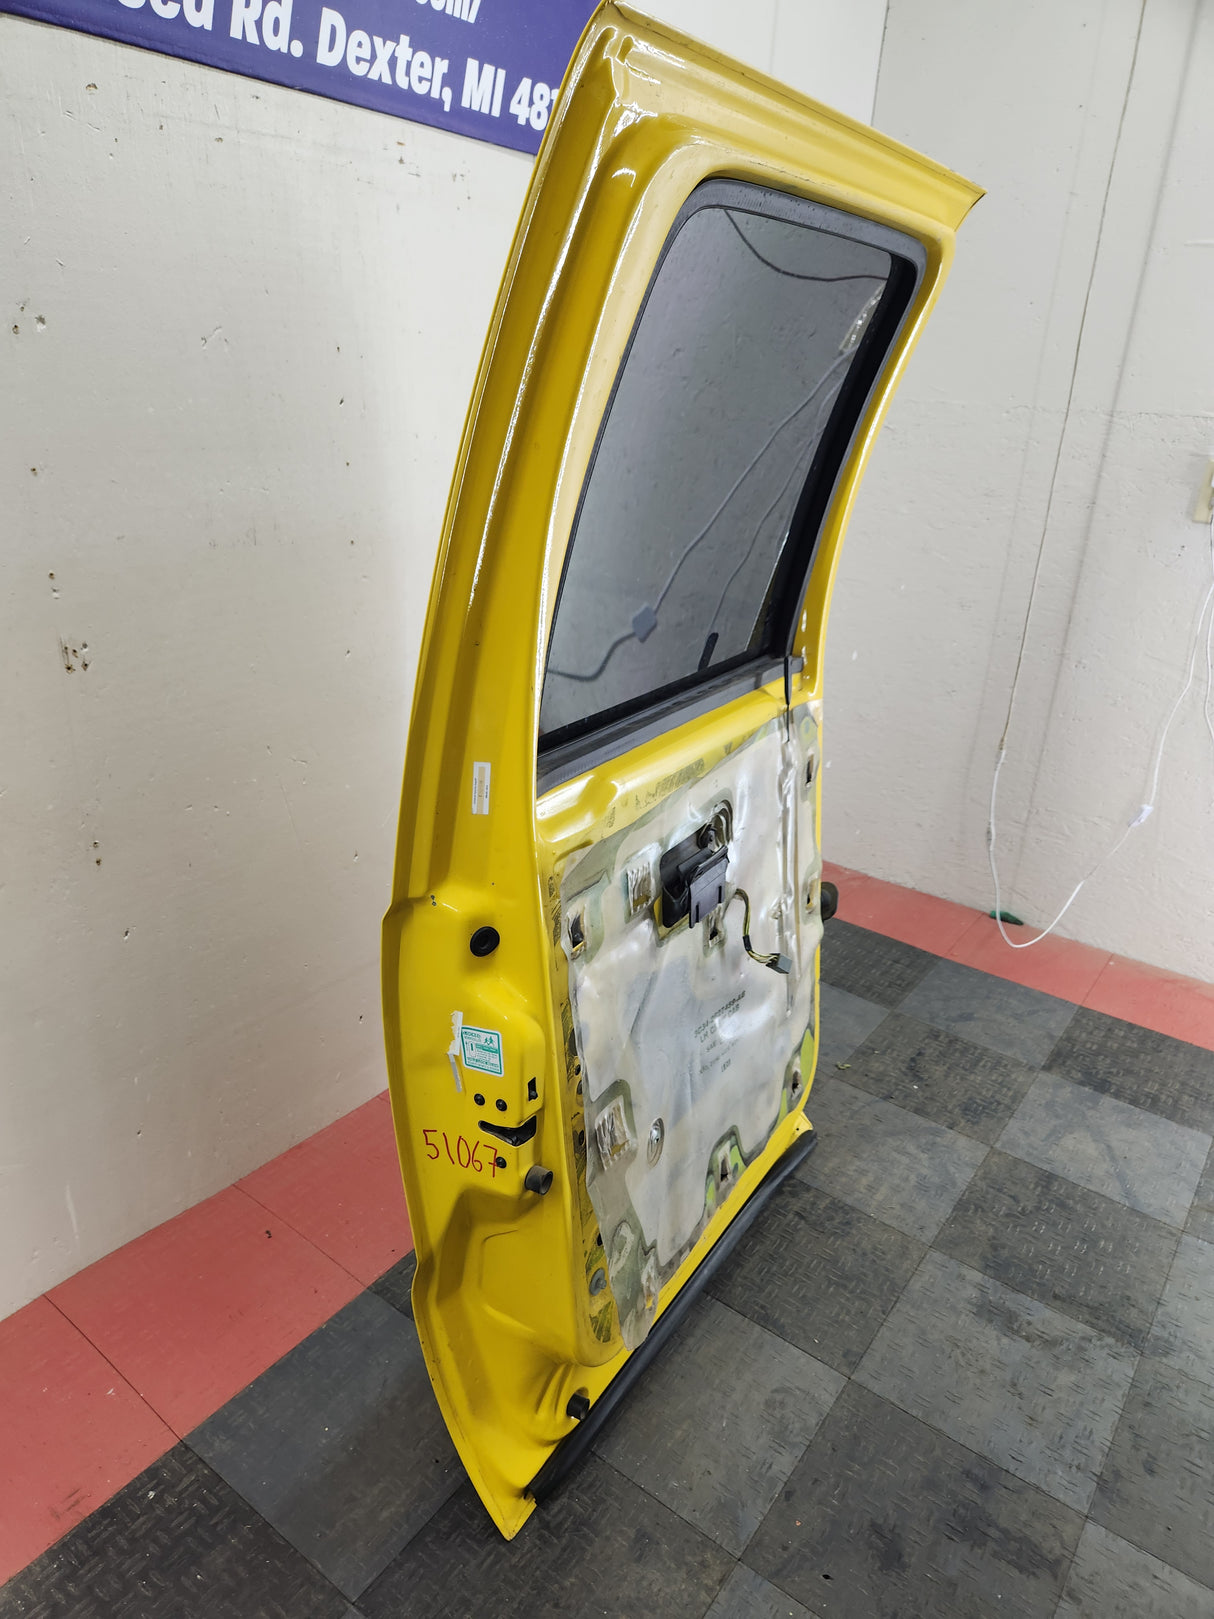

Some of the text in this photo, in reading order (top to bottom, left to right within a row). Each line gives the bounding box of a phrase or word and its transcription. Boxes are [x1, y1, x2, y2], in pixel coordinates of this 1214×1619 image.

[230, 0, 304, 58] Rd.
[316, 7, 452, 112] Dexter,
[461, 57, 506, 118] MI
[422, 1129, 498, 1178] 51067
